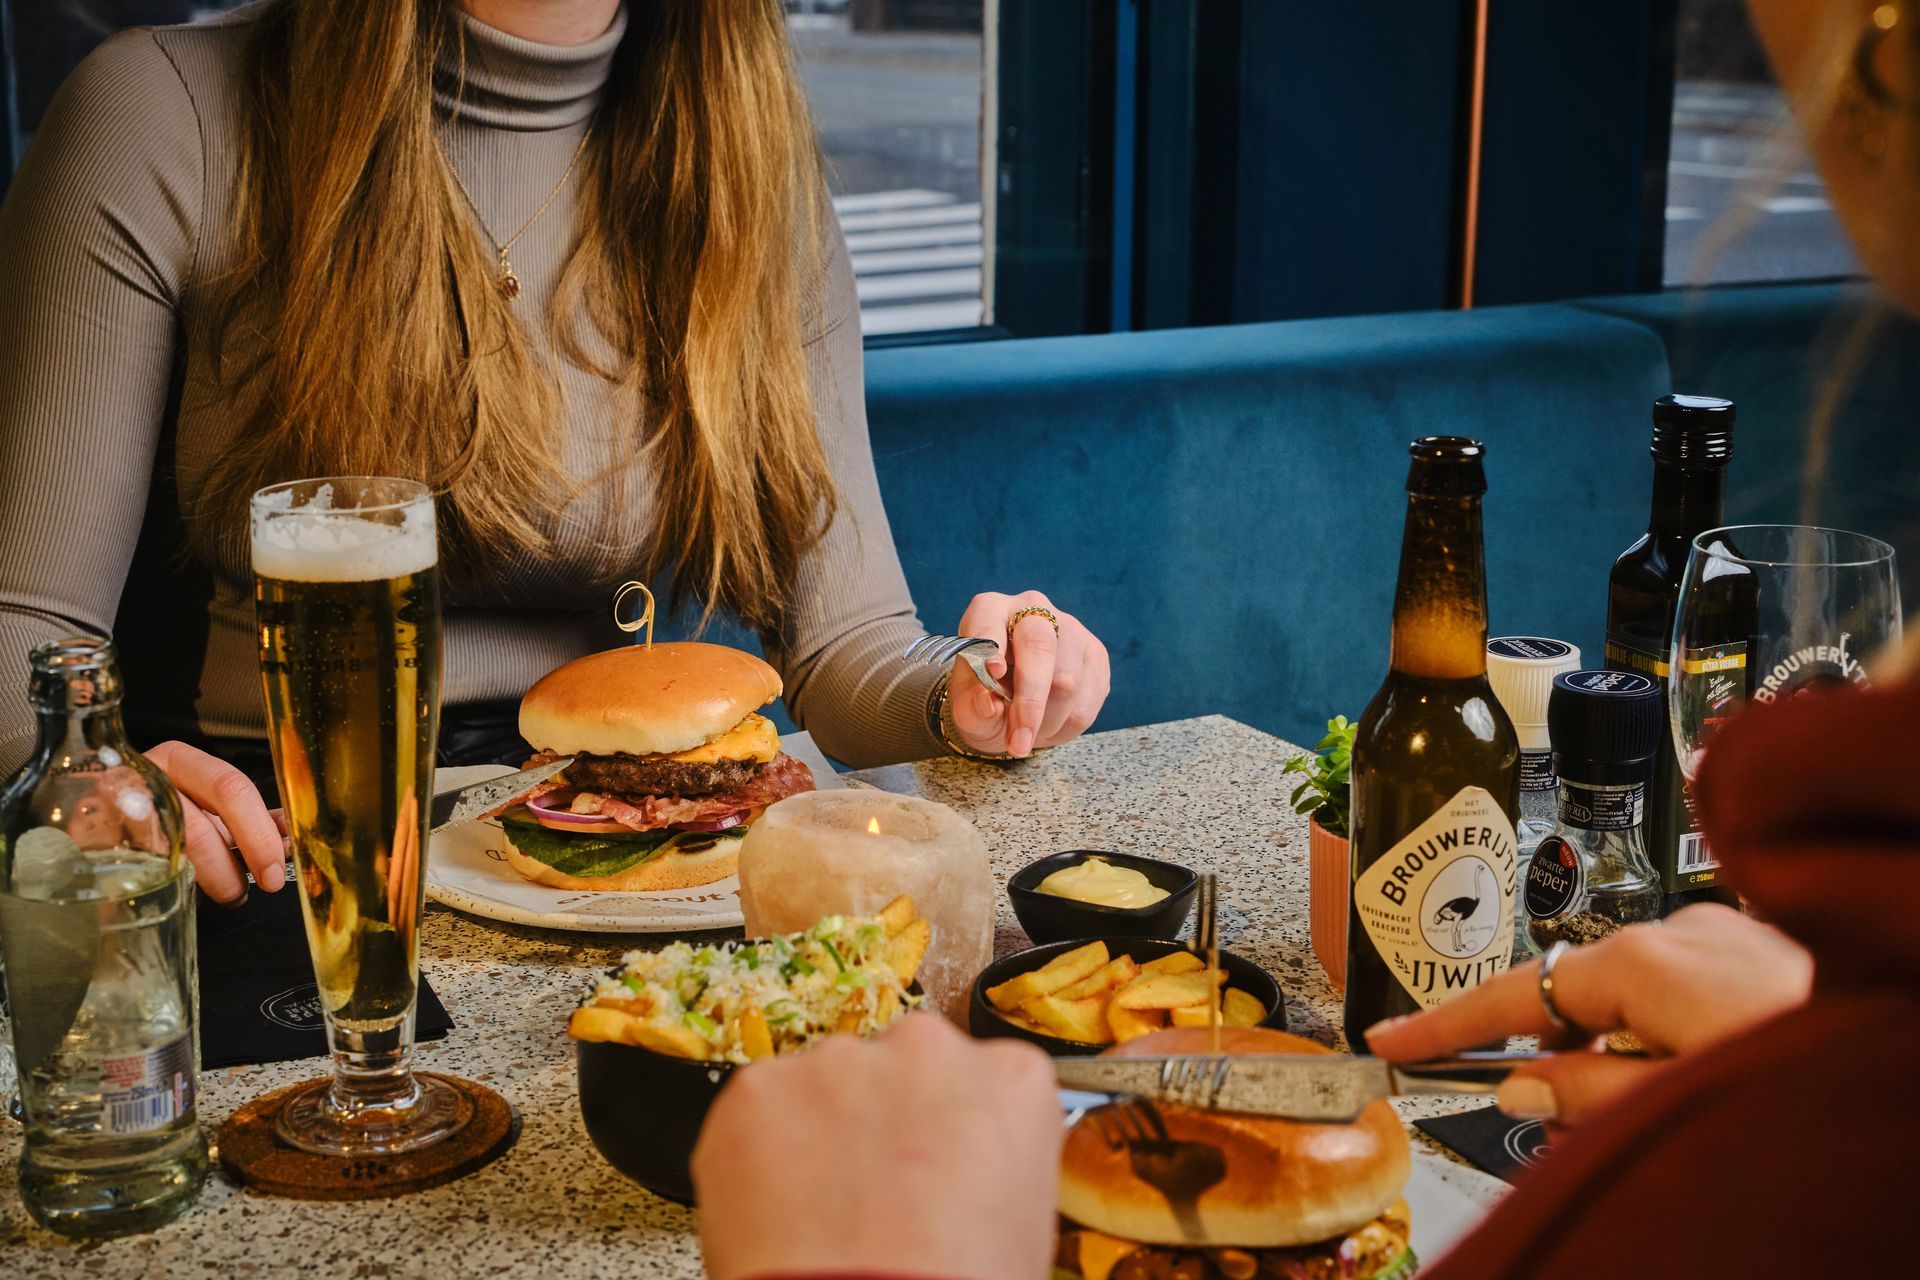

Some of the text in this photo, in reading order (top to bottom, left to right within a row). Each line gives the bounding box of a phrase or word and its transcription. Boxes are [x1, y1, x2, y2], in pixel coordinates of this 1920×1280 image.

[1538, 856, 1565, 875] zwarte
[1562, 846, 1574, 866] NIEUW
[1530, 864, 1569, 894] peper
[1371, 920, 1411, 936] KRACHTIG
